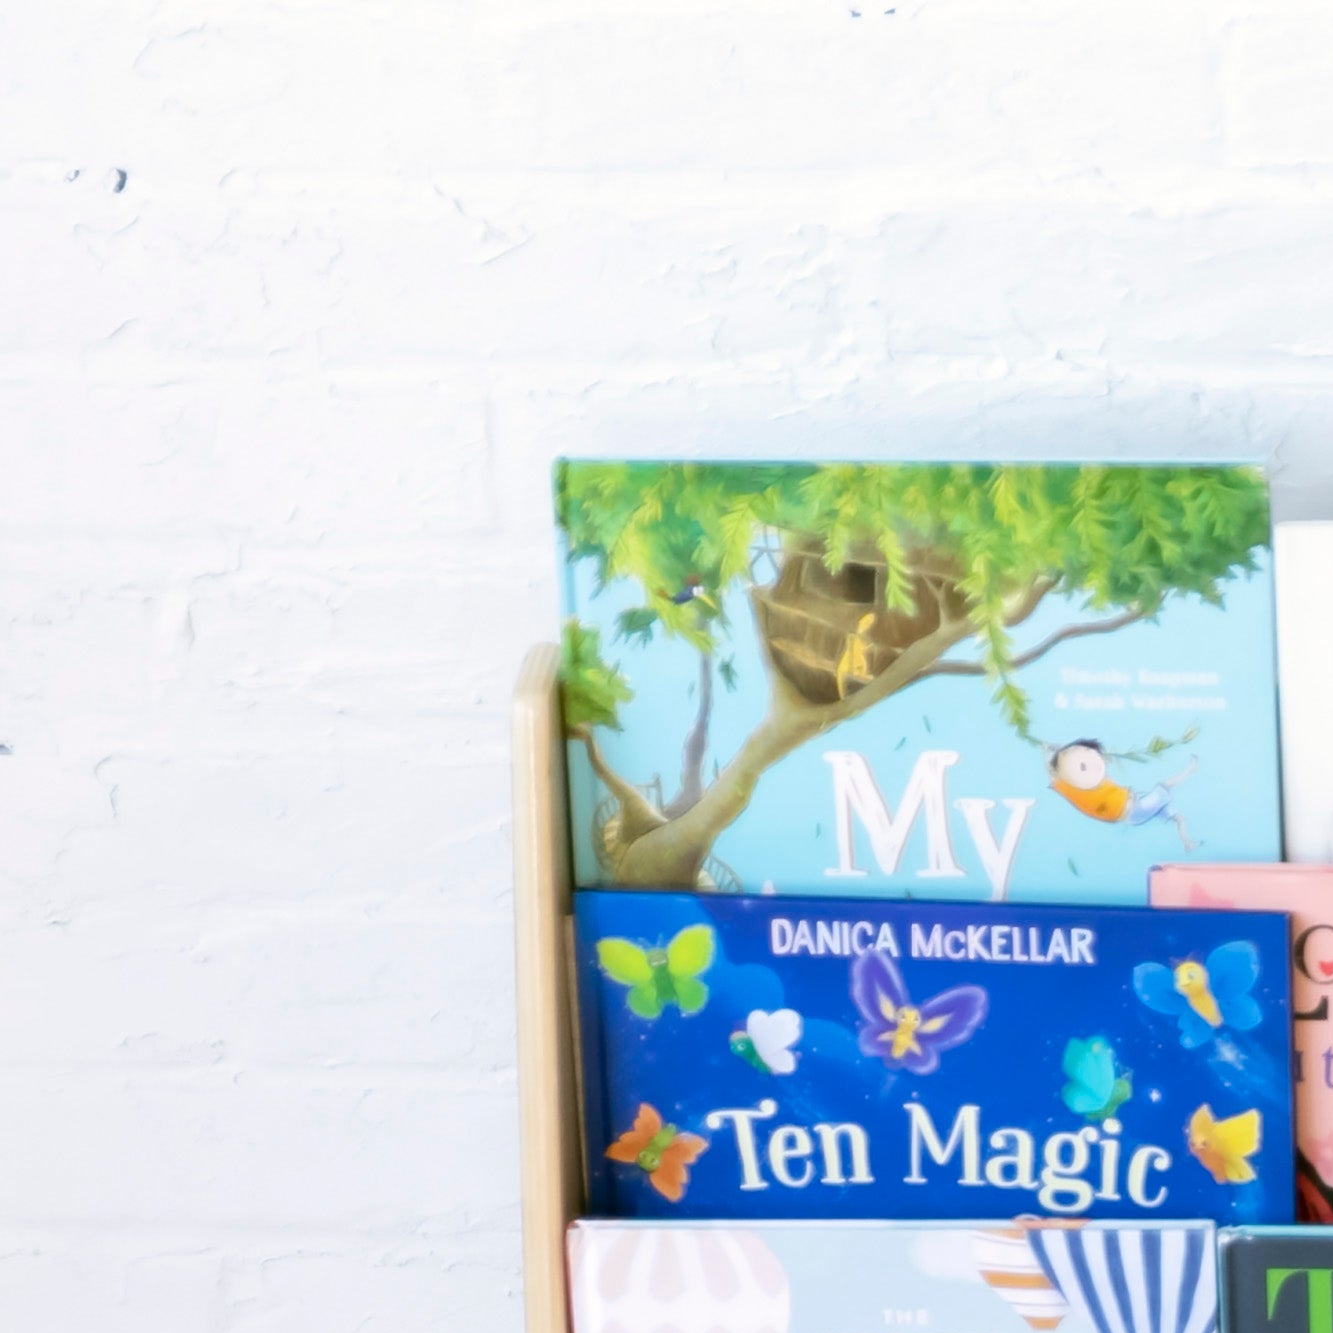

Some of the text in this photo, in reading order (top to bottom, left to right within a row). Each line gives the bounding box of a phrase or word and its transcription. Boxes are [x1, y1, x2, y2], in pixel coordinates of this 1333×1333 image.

[822, 750, 1037, 903] My
[771, 918, 898, 958] DANICA
[706, 1099, 1171, 1213] Ten Magic
[882, 1308, 930, 1326] THE
